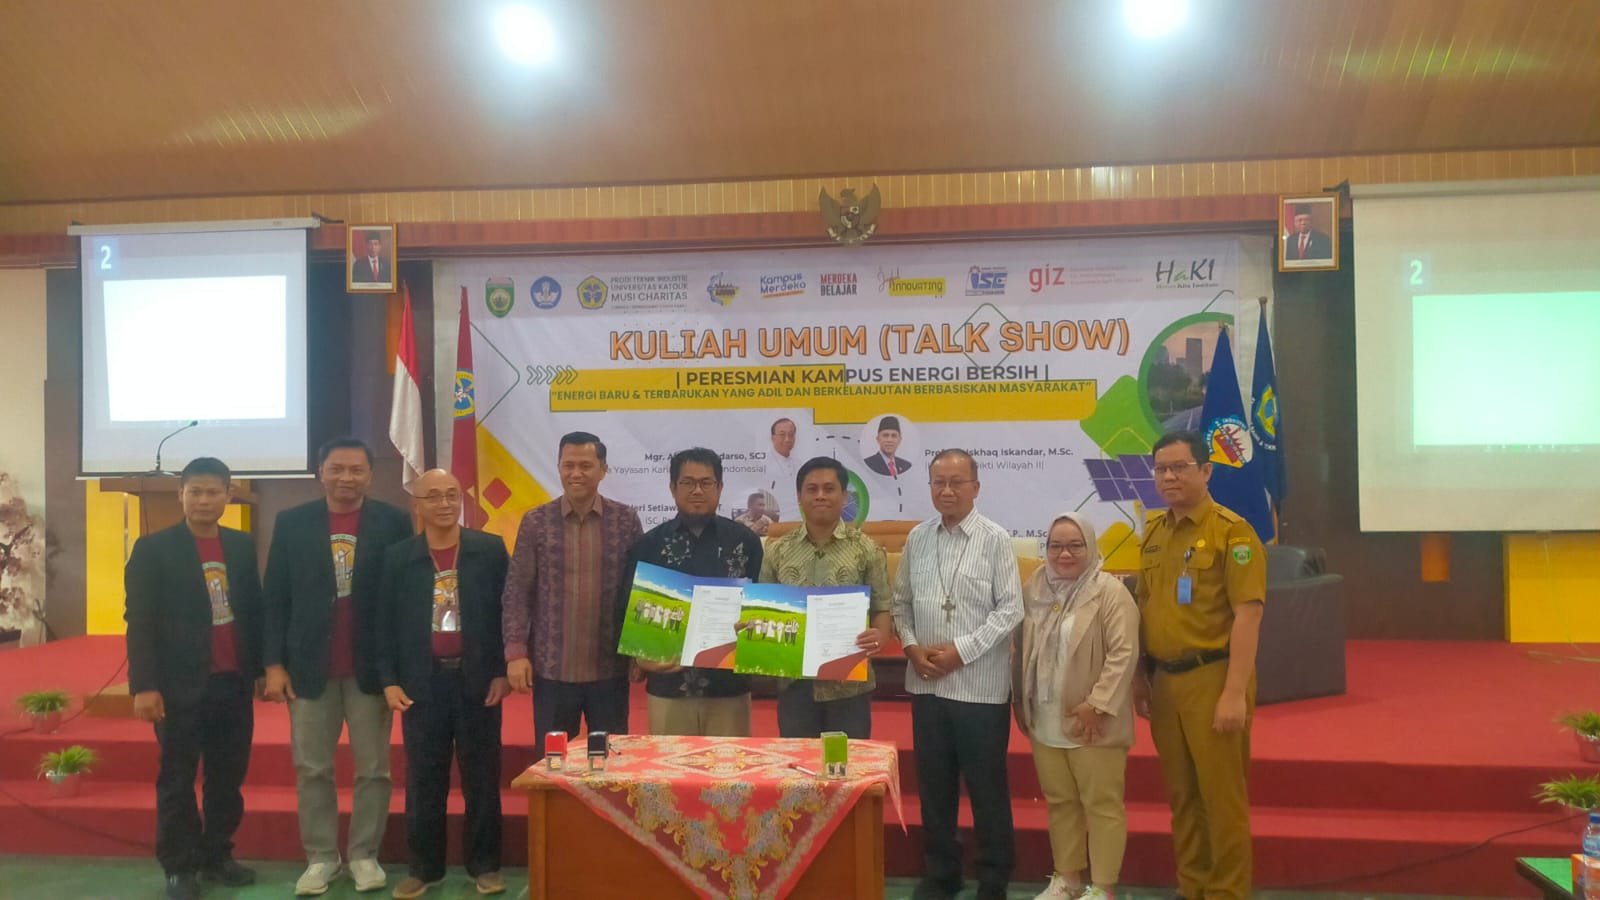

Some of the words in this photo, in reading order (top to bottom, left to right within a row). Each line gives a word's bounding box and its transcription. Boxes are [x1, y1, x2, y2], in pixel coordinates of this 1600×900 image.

[101, 245, 111, 270] 2
[820, 272, 857, 284] MERDEKA
[1029, 264, 1065, 292] giz
[1410, 260, 1422, 285] 2
[611, 292, 635, 302] MUSI
[638, 291, 688, 302] CHARITAS
[820, 284, 857, 296] BELAJAR
[609, 328, 747, 361] KULIAH
[758, 325, 867, 358] UMUM
[879, 322, 991, 361] (TALK
[999, 318, 1130, 356] SHOW)
[686, 369, 796, 386] PERESMIAN
[801, 367, 883, 384] KAMPUS
[889, 366, 960, 382] ENERGI
[966, 364, 1038, 380] BERSIH
[600, 390, 630, 400] BARU
[632, 391, 641, 399] &
[643, 389, 720, 399] TERBARUKAN
[722, 387, 755, 398] YANG
[757, 386, 783, 397] ADIL
[786, 386, 811, 397] DAN
[814, 384, 912, 397] BERKELANJUTAN
[914, 383, 997, 394] BERBASISKAN
[644, 453, 665, 462] Mgr.
[720, 452, 747, 461] darso,
[749, 452, 766, 460] SCJ
[615, 466, 650, 475] Yayasan
[647, 503, 676, 512] Setiaw
